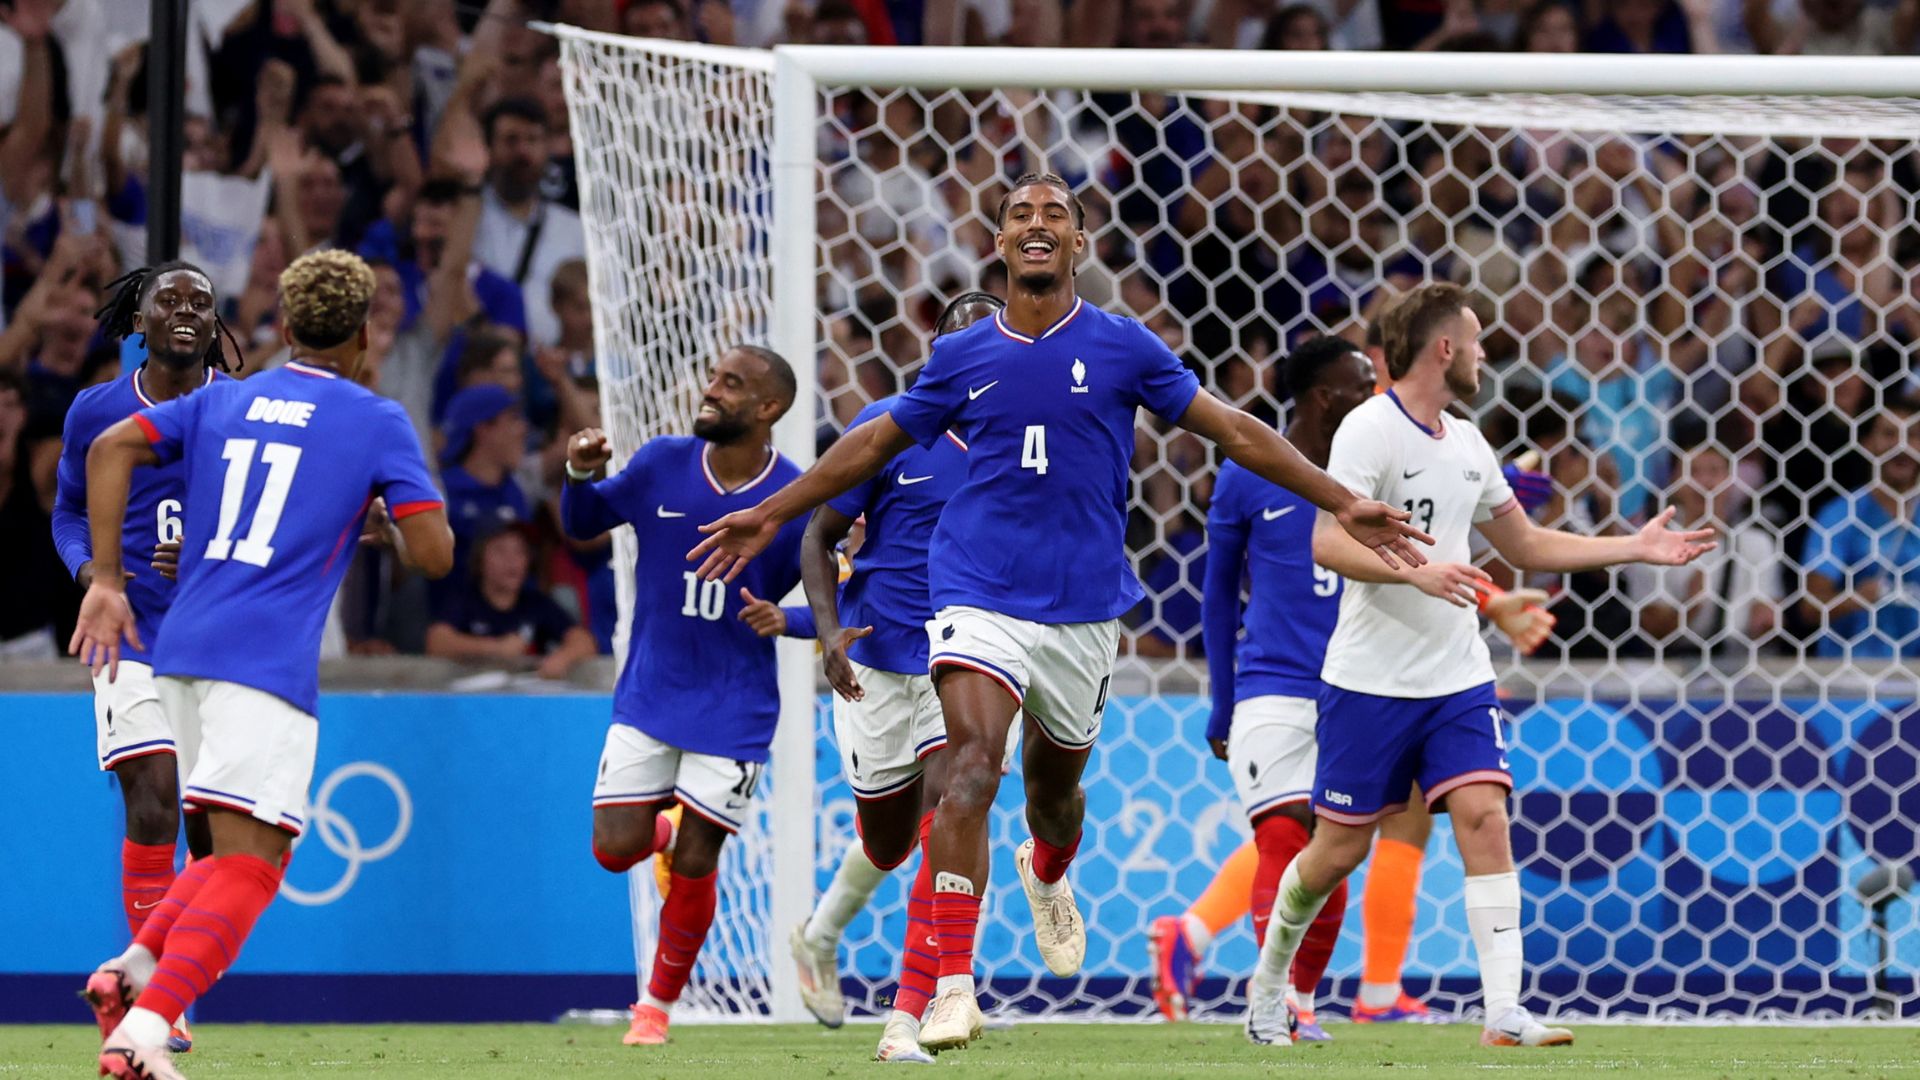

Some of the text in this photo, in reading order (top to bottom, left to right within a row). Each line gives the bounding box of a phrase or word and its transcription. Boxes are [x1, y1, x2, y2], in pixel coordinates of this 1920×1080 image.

[245, 396, 316, 428] DOUE
[1021, 425, 1048, 475] 4
[1462, 469, 1482, 482] USA
[156, 499, 183, 545] 6
[203, 438, 302, 568] 11
[1403, 498, 1434, 535] 13
[681, 571, 726, 621] 10
[1313, 562, 1338, 597] 9
[1488, 707, 1507, 750] 1
[1325, 789, 1353, 806] USA
